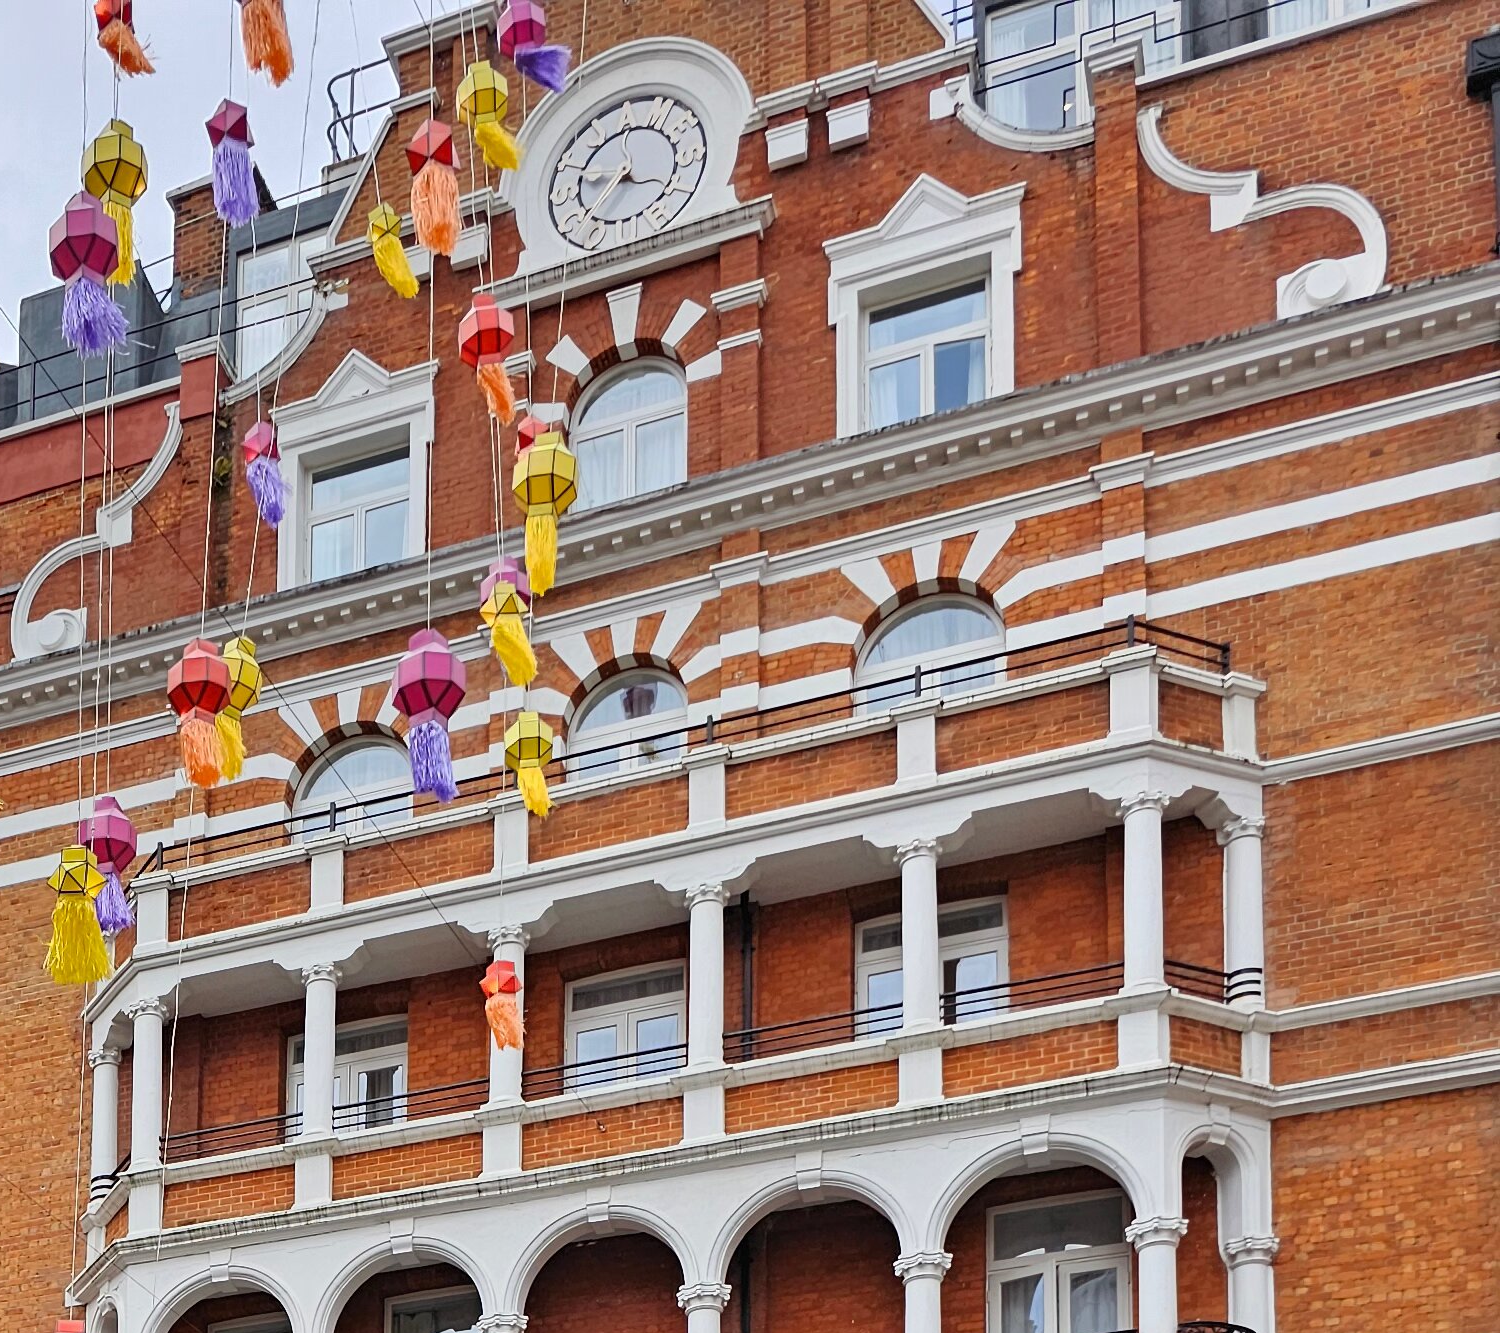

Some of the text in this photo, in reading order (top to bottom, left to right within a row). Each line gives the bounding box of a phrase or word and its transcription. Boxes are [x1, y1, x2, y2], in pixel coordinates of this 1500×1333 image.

[550, 96, 706, 206] ST JAMES
[557, 174, 696, 250] COURT
